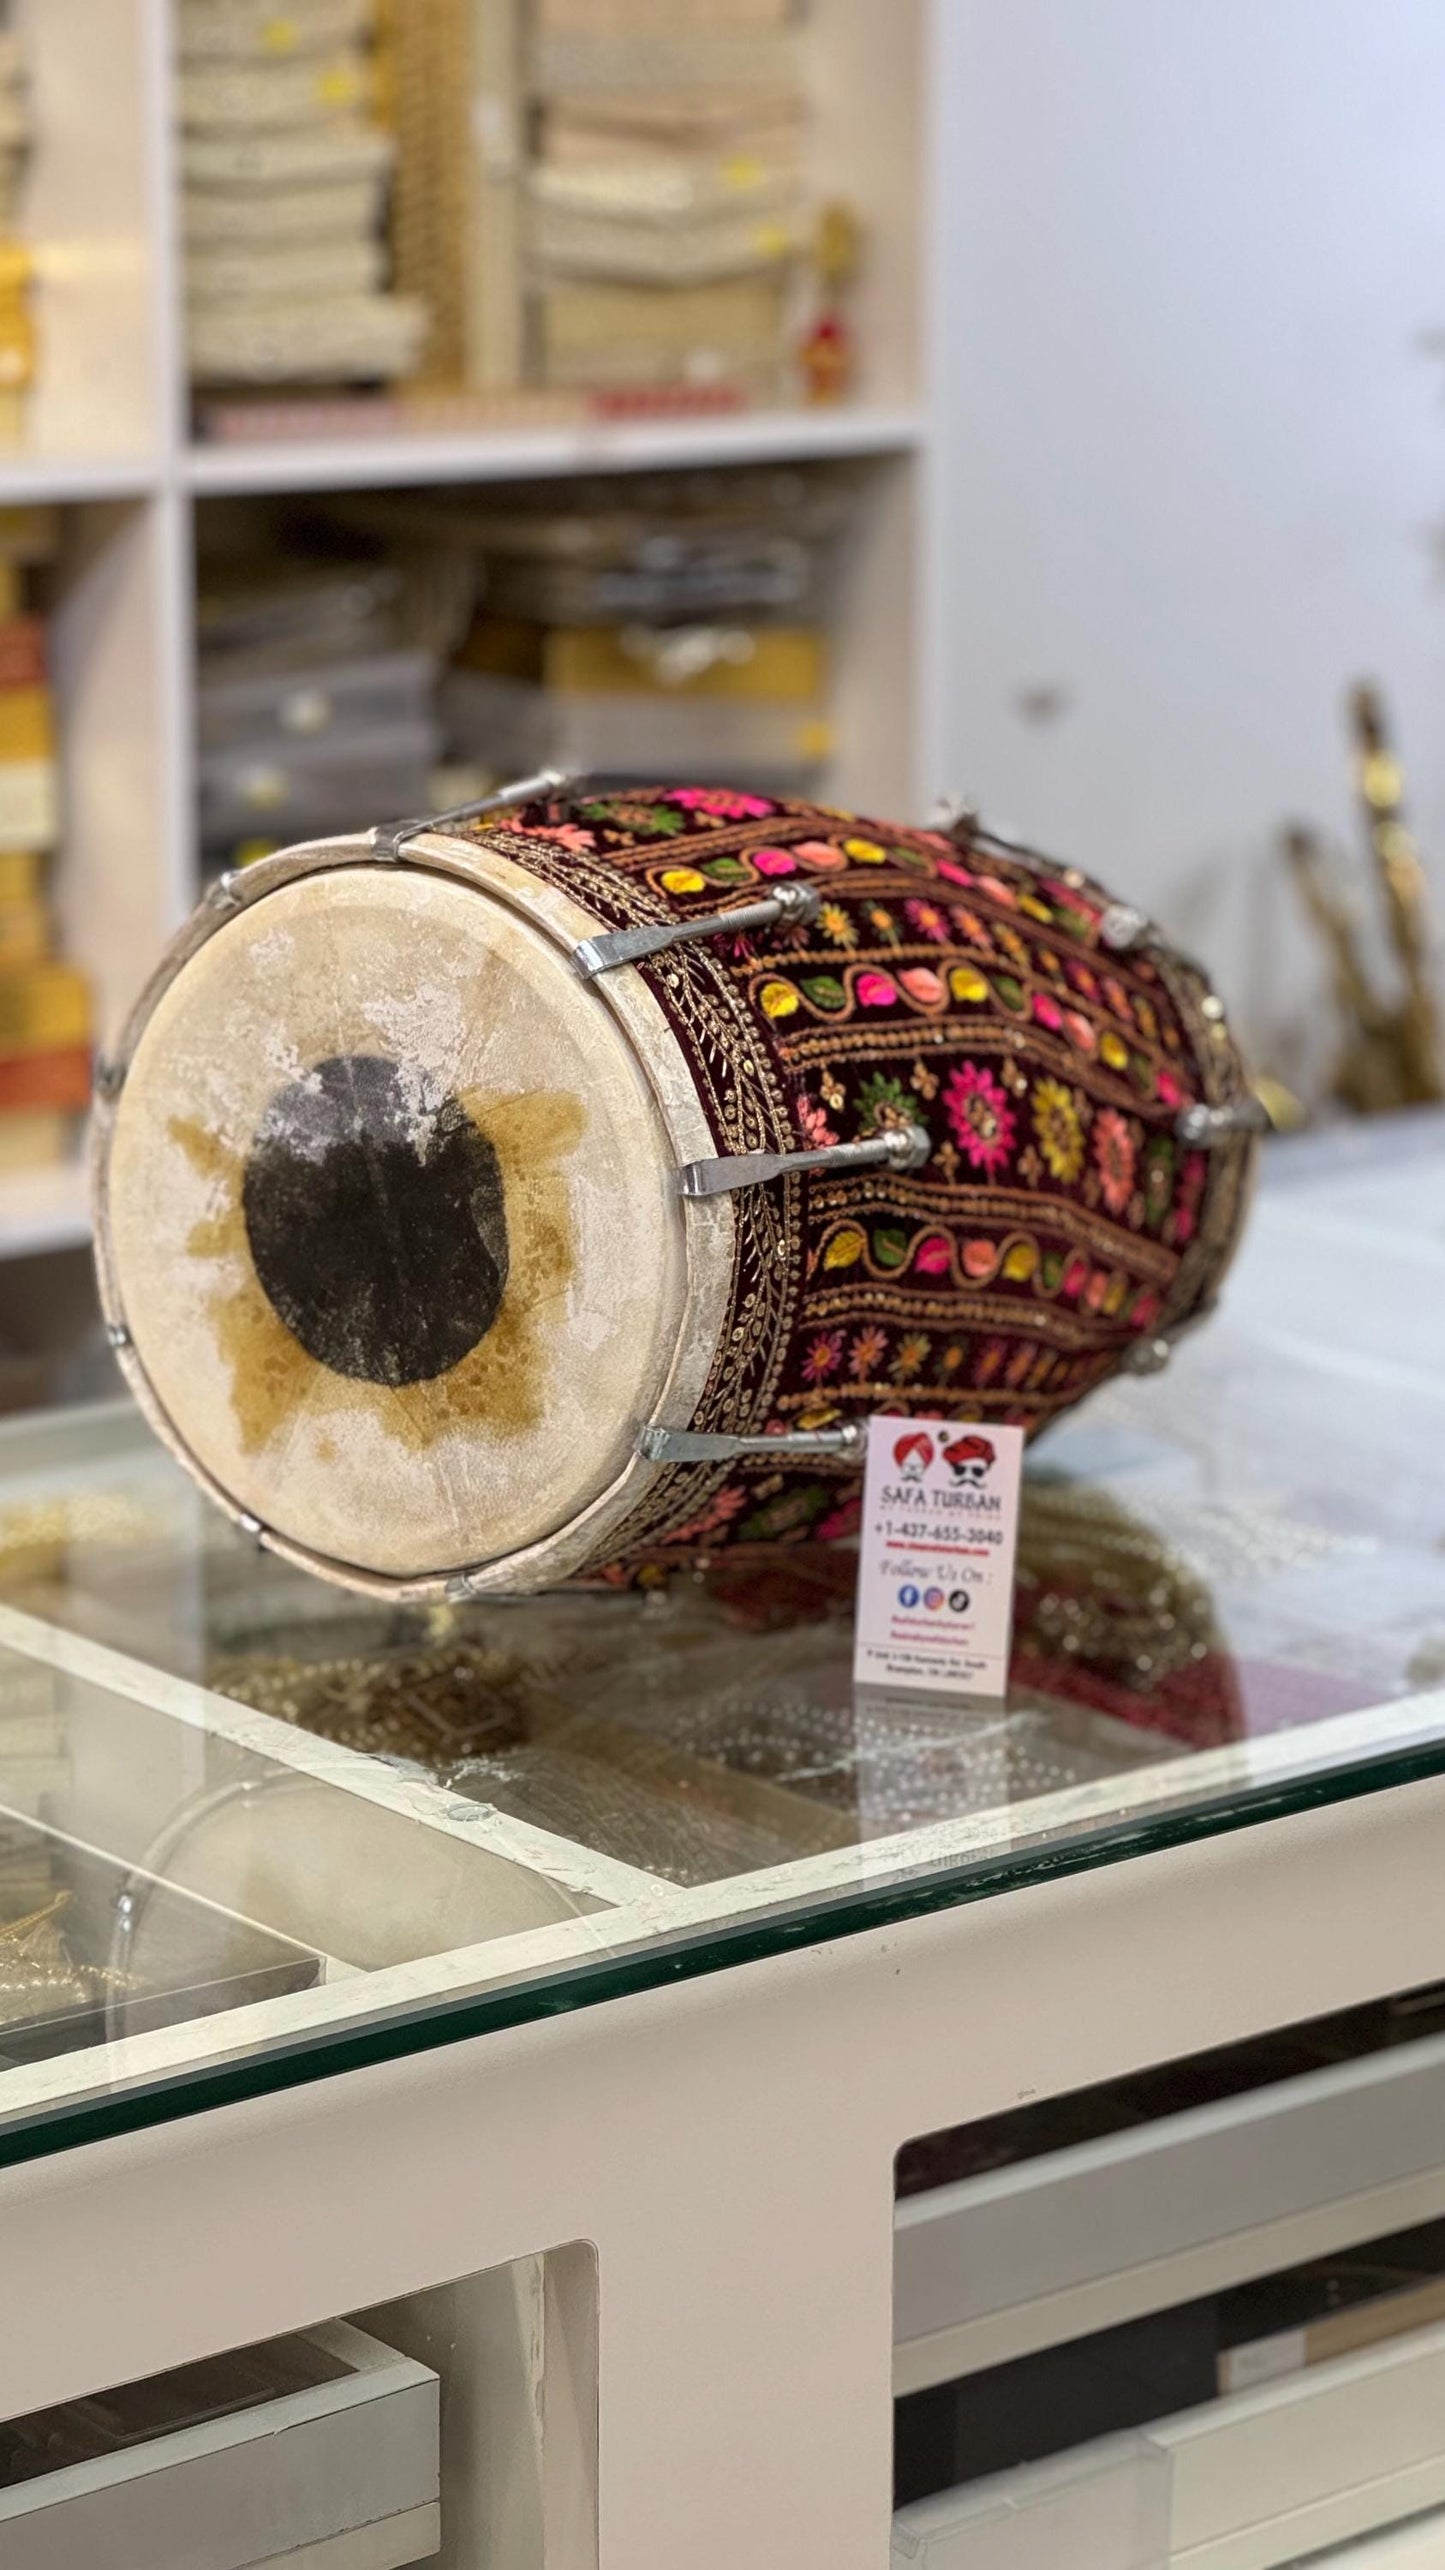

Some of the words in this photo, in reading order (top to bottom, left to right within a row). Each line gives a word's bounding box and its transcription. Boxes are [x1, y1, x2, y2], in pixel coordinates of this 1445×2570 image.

[881, 1486, 927, 1505] SAFA
[932, 1490, 1002, 1512] TURBAN
[879, 1559, 932, 1578] Follow
